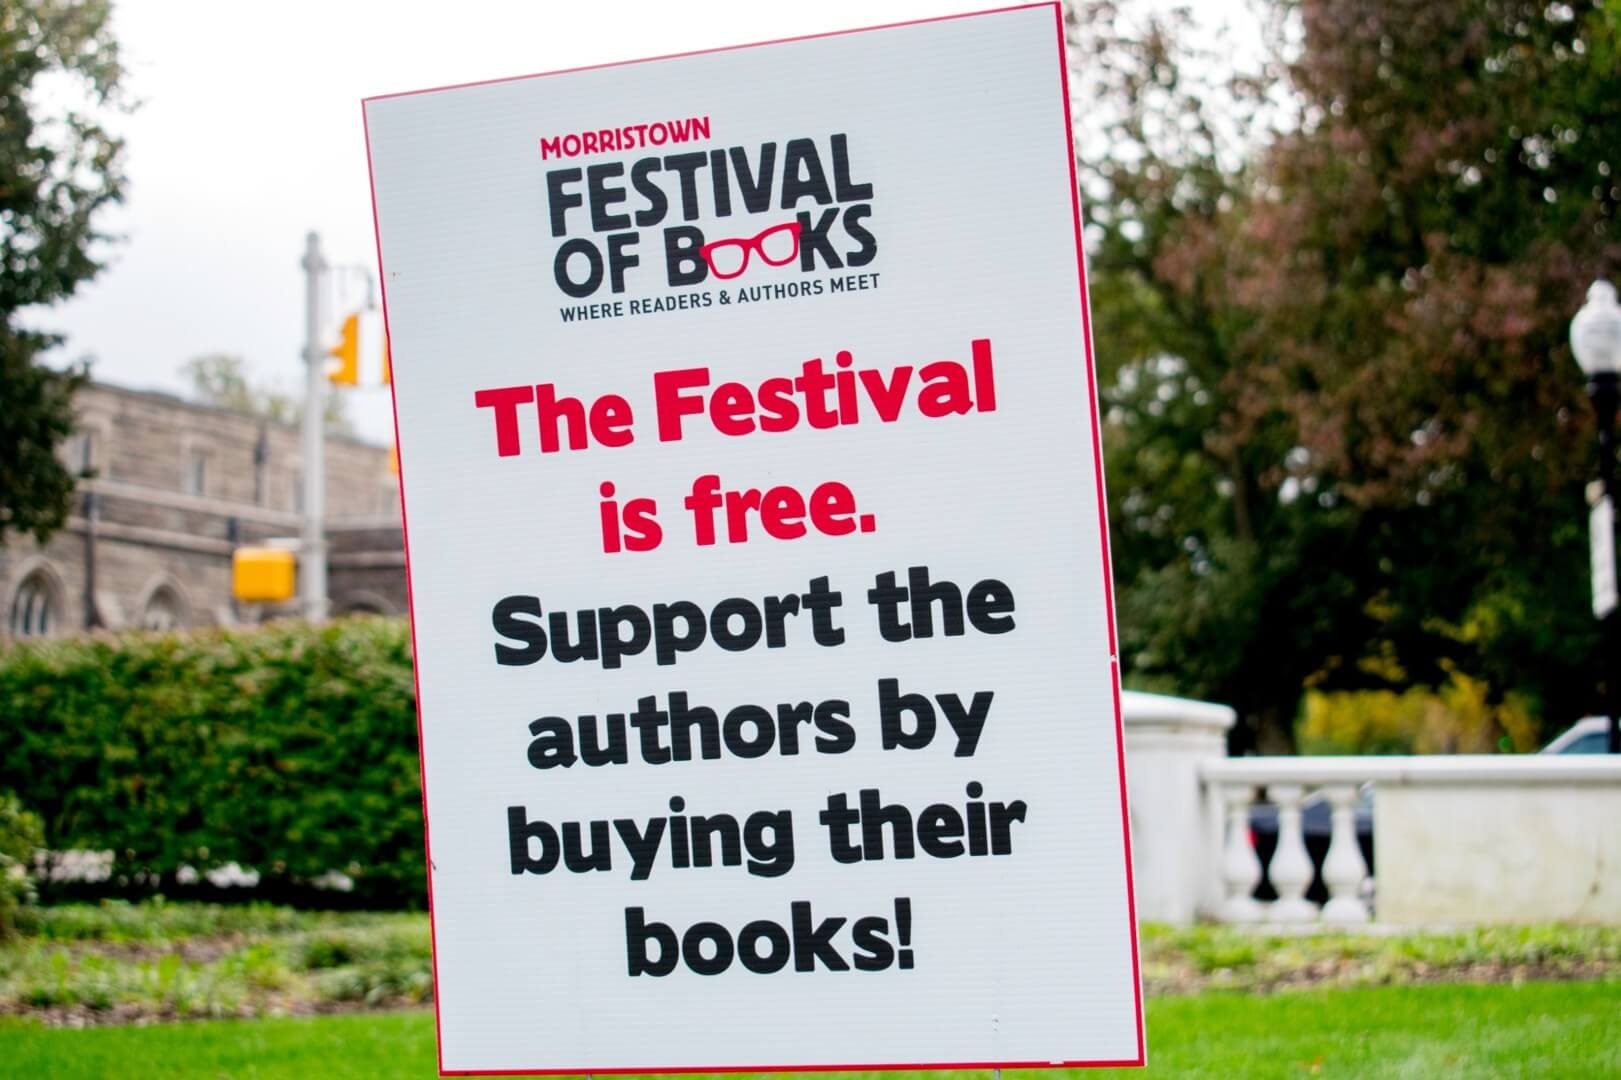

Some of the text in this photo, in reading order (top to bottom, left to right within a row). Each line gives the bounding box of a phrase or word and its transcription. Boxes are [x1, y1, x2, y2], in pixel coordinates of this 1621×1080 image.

[540, 116, 711, 161] MORRISTOWN
[546, 133, 874, 239] FESTIVAL
[553, 203, 879, 300] OF BOOKS
[559, 273, 880, 322] WHERE READERS & AUTHORS MEET
[475, 338, 997, 458] The Festival
[599, 474, 877, 554] is free.
[491, 565, 1016, 671] Support the
[527, 678, 995, 770] authors by
[507, 781, 1028, 881] buying their
[624, 897, 916, 978] books!
